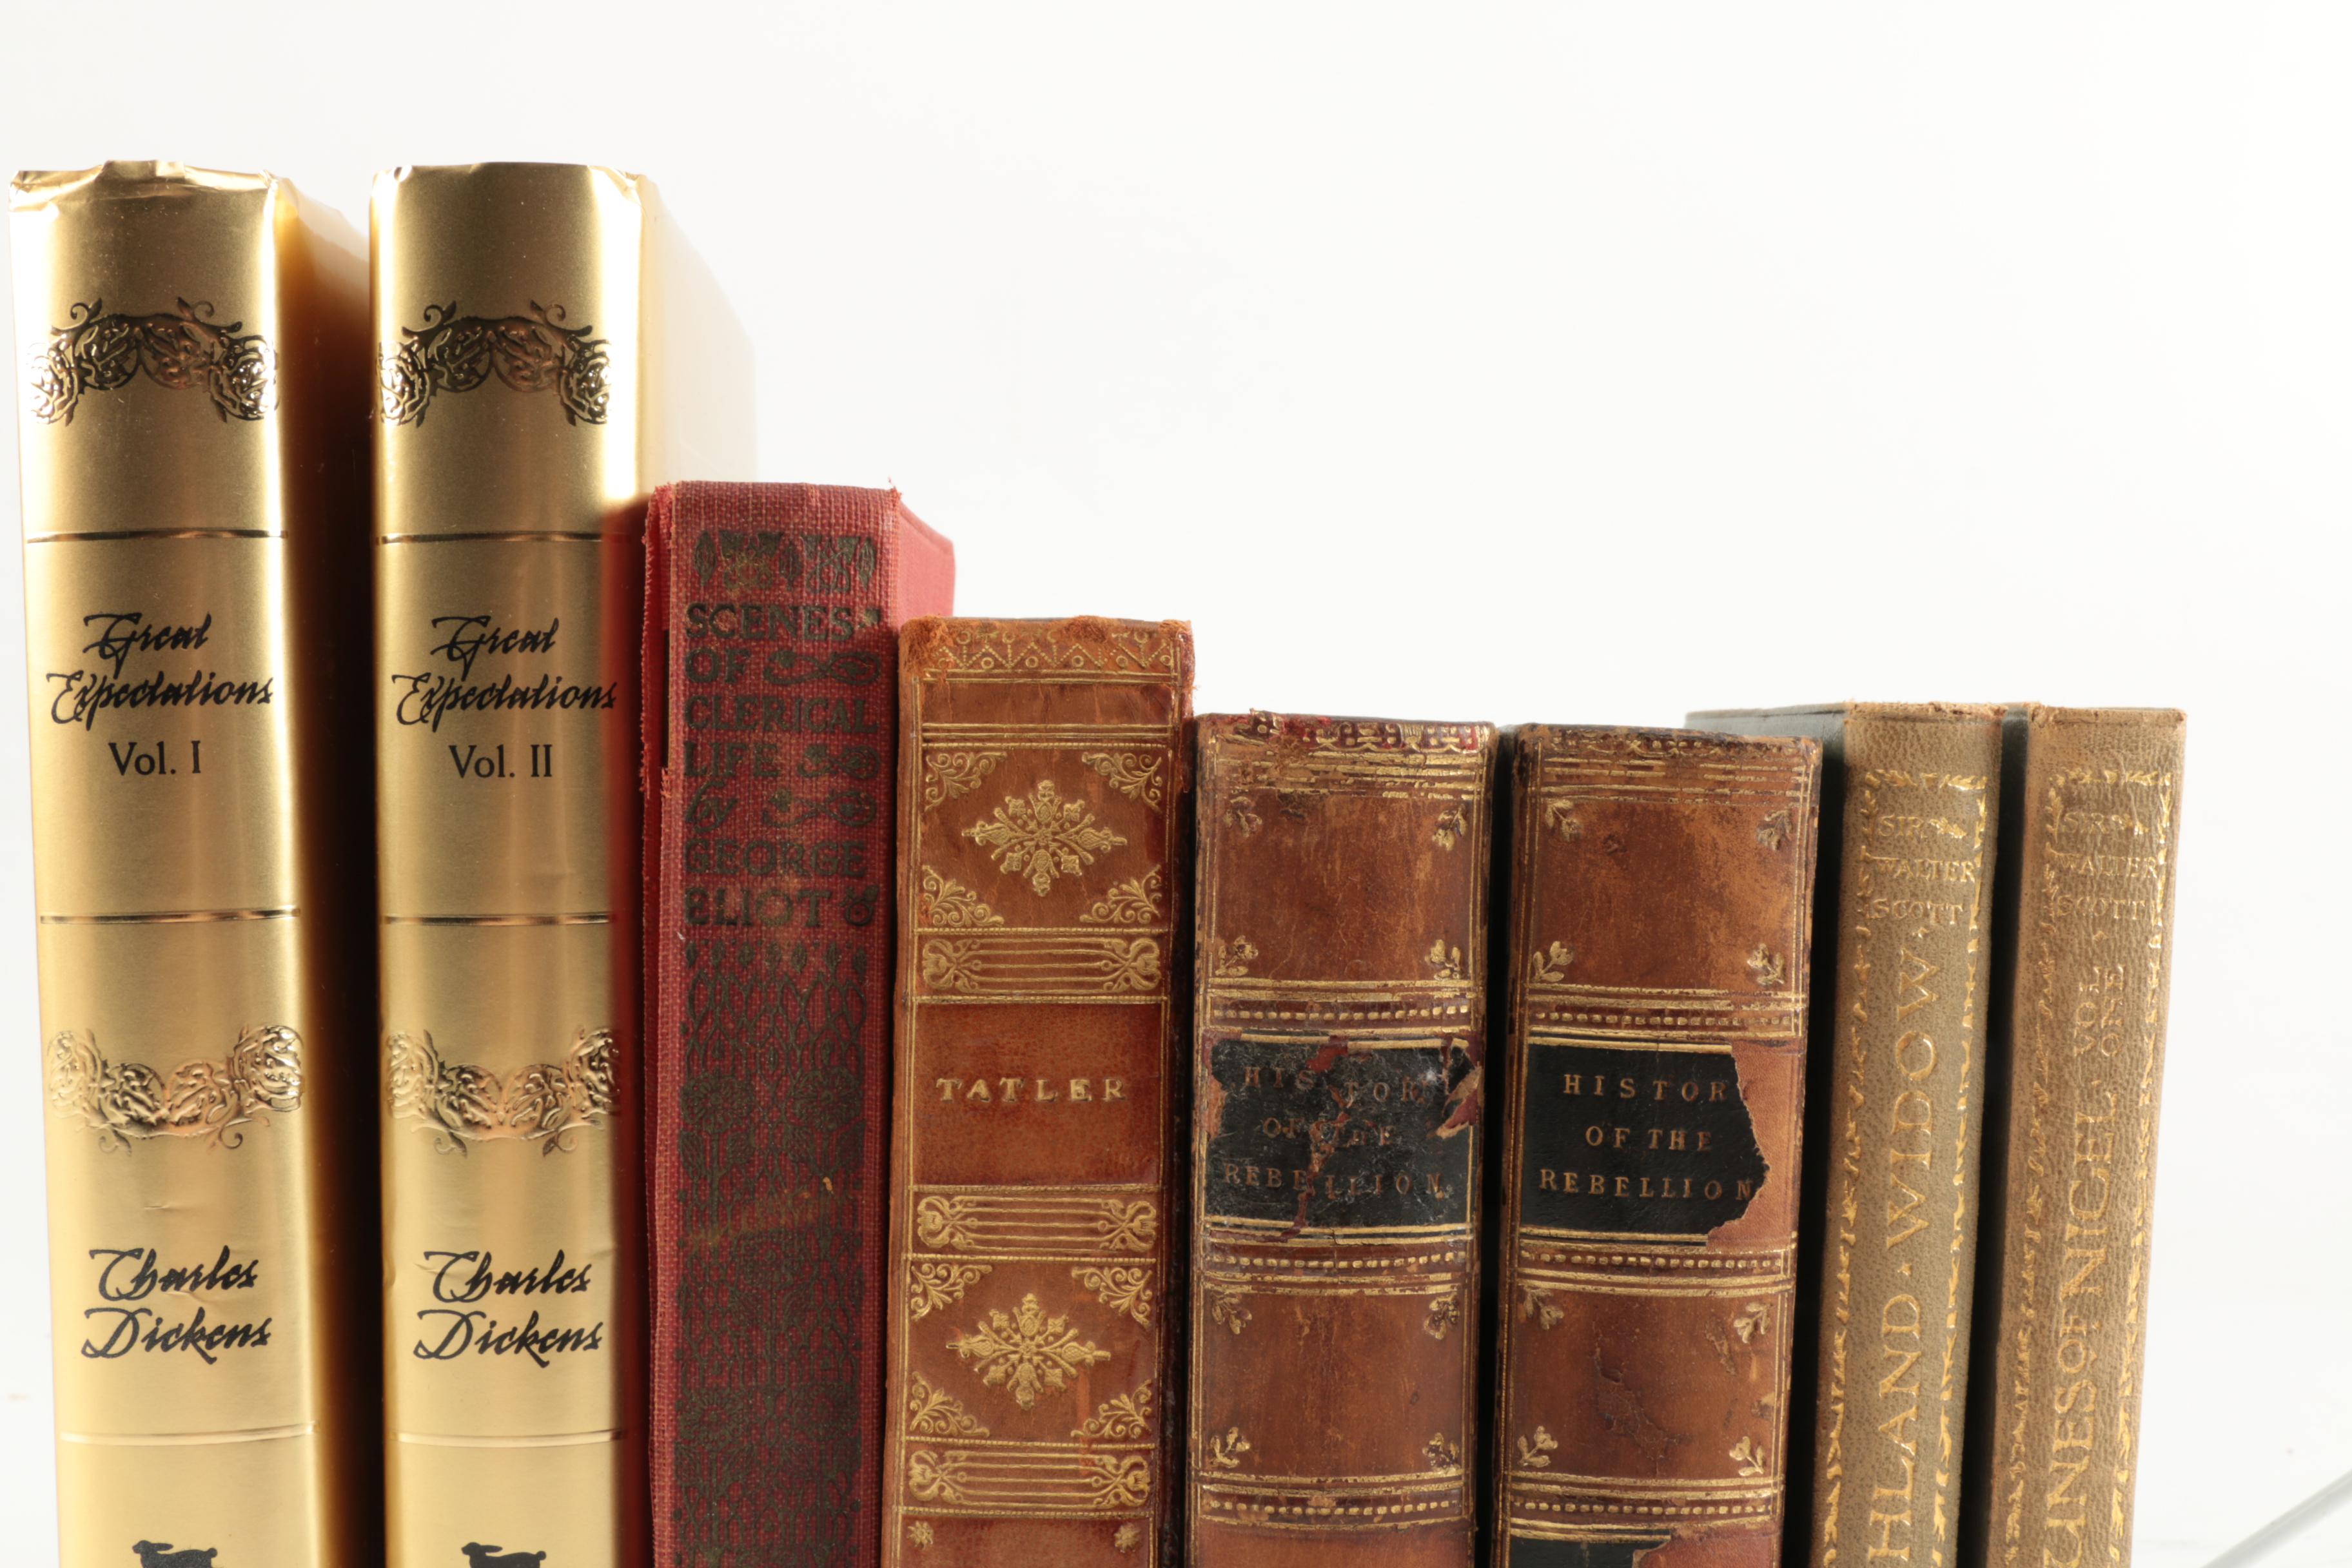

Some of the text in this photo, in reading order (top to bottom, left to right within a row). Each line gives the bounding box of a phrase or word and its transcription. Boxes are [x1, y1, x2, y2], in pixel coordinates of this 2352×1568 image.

[685, 602, 854, 642] SCENES
[83, 612, 212, 678] Great
[431, 615, 560, 681] Great
[685, 648, 750, 684] OF
[46, 670, 273, 731] Expectations
[392, 672, 618, 732] Expectations
[684, 694, 878, 734] CLERICAL
[108, 740, 202, 776] Vol. I
[447, 743, 554, 779] Vol. II
[683, 741, 779, 778] LIFE
[1877, 814, 1928, 839] SIR
[684, 839, 867, 878] GEORGE
[1868, 856, 1976, 883] WALTER
[2057, 852, 2158, 879] WALTER
[684, 887, 832, 928] ELIOT
[1865, 898, 1964, 925] SCOTT
[2057, 895, 2146, 920] SCOTT
[936, 1077, 1127, 1103] TATLER
[1886, 946, 1939, 1250] WIDOW
[1262, 1117, 1304, 1139] OF
[1585, 1126, 1712, 1152] OF THE
[1539, 1168, 1754, 1201] REBELLION
[2061, 1092, 2117, 1303] NIGEL
[89, 1245, 259, 1302] Charles
[423, 1249, 592, 1304] Charles
[81, 1306, 273, 1366] Dickens
[413, 1309, 604, 1369] Dickens
[2057, 1308, 2090, 1374] OF
